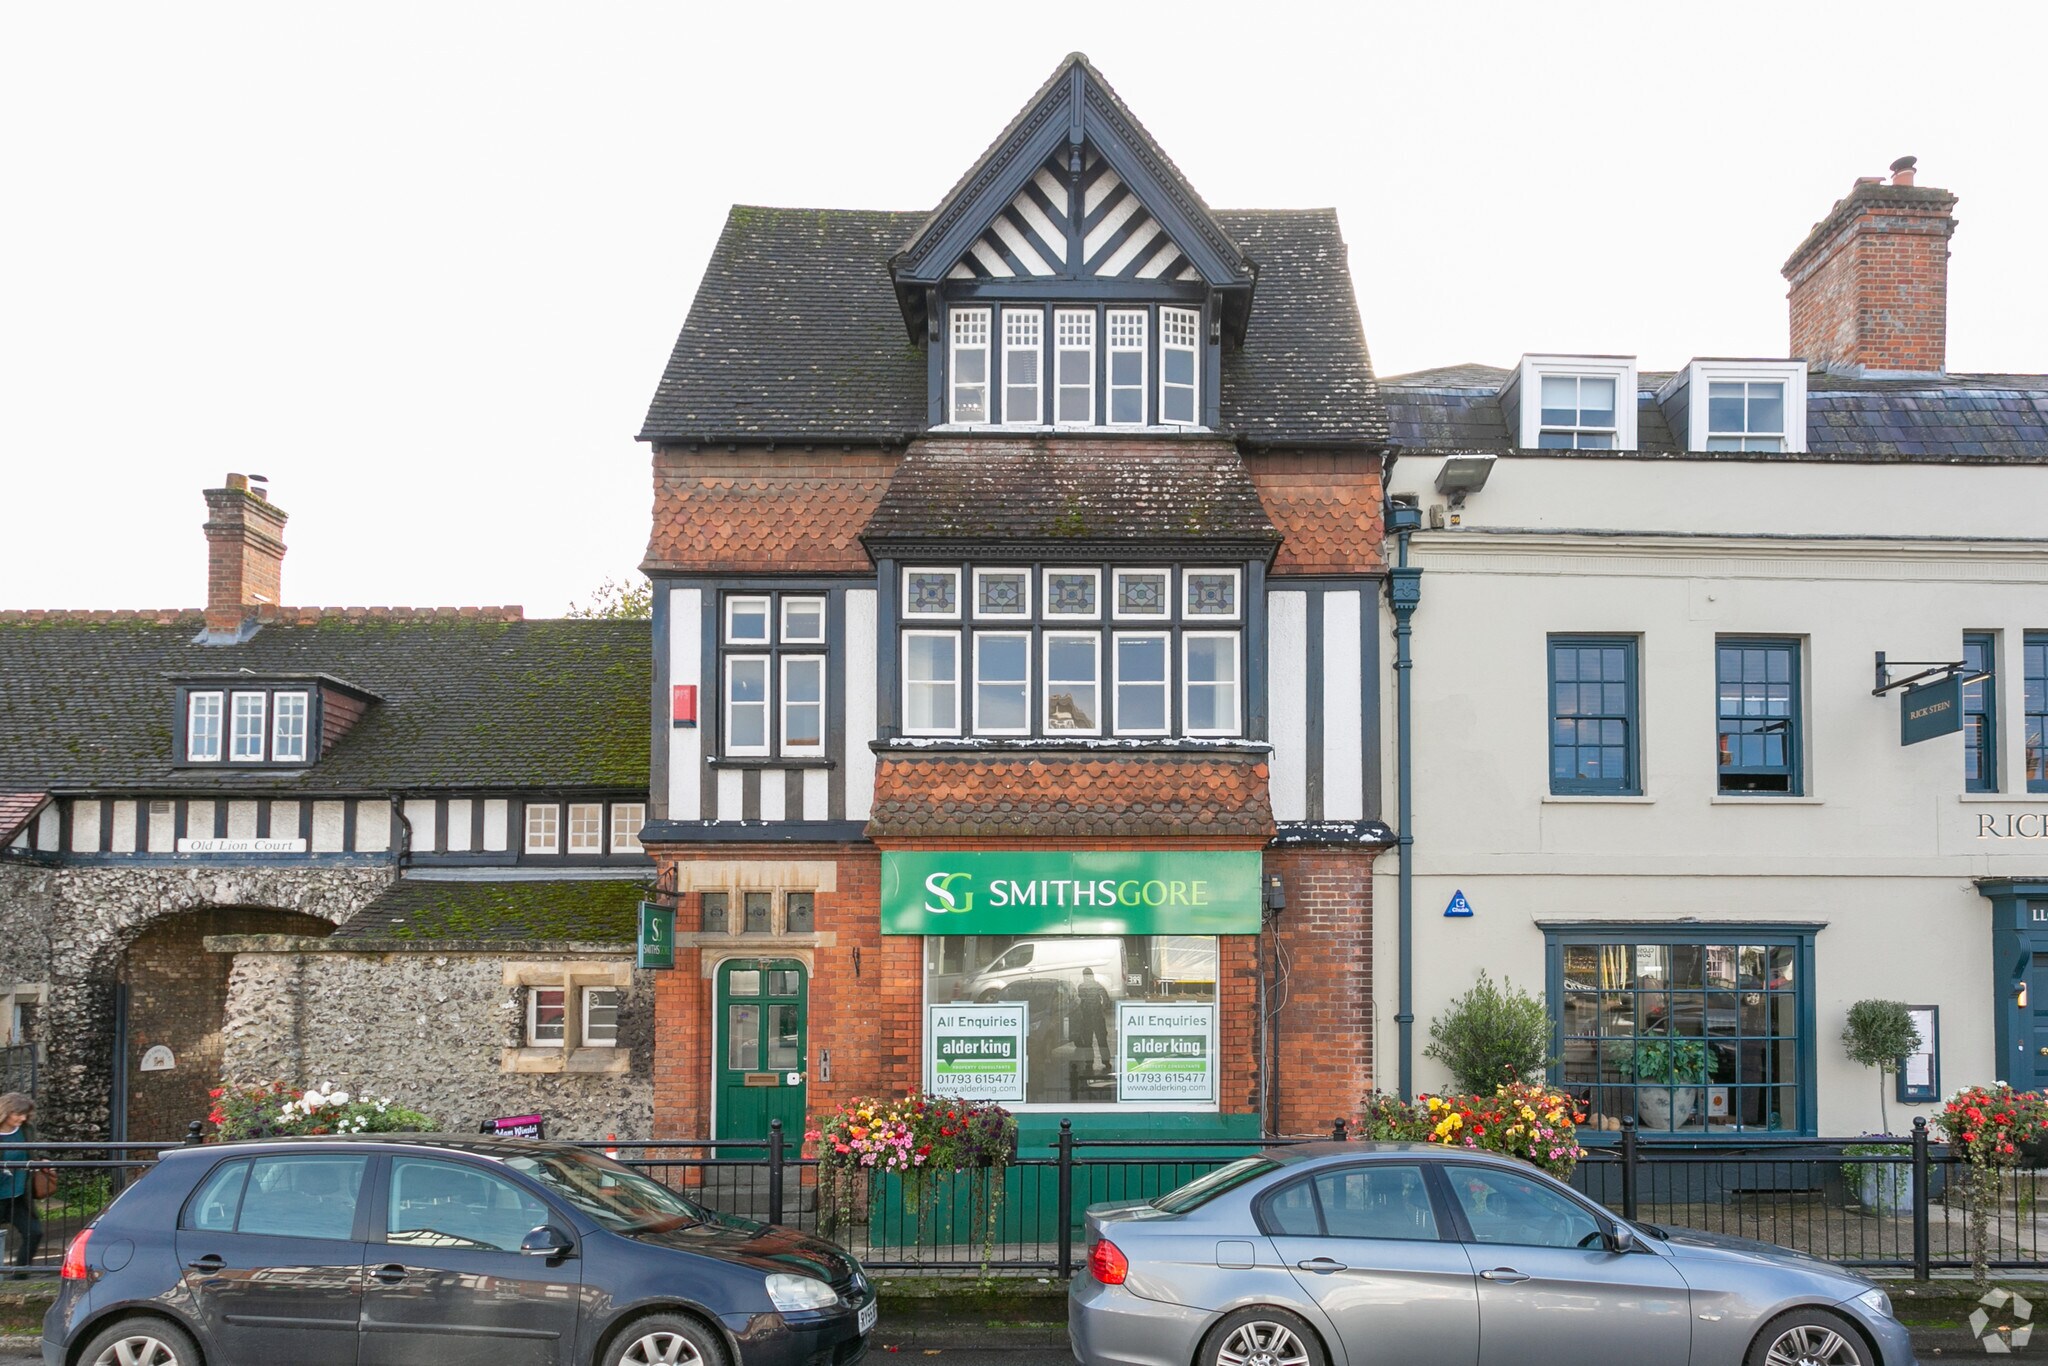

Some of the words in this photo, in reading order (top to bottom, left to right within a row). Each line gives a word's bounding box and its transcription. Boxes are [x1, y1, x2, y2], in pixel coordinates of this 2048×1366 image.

[1910, 708, 1928, 720] RICK
[1929, 700, 1951, 714] STEIN
[190, 840, 213, 851] Old
[219, 840, 248, 851] Lion
[254, 840, 293, 851] Court
[989, 880, 1209, 907] SMITHSGORE
[2032, 909, 2048, 922] LL
[937, 1016, 954, 1027] All
[958, 1016, 1017, 1029] Enquiries
[1127, 1015, 1144, 1026] All
[1148, 1015, 1207, 1028] Enquiries
[942, 1039, 979, 1054] alder
[980, 1039, 1011, 1057] king
[1132, 1038, 1169, 1053] alder
[1170, 1038, 1201, 1056] king
[937, 1074, 972, 1084] 01793
[975, 1074, 1016, 1084] 615477
[1127, 1073, 1162, 1083] 01793
[1165, 1073, 1206, 1083] 615477
[937, 1084, 1017, 1093] www.alderking.com
[1127, 1084, 1206, 1093] www.alderking.com
